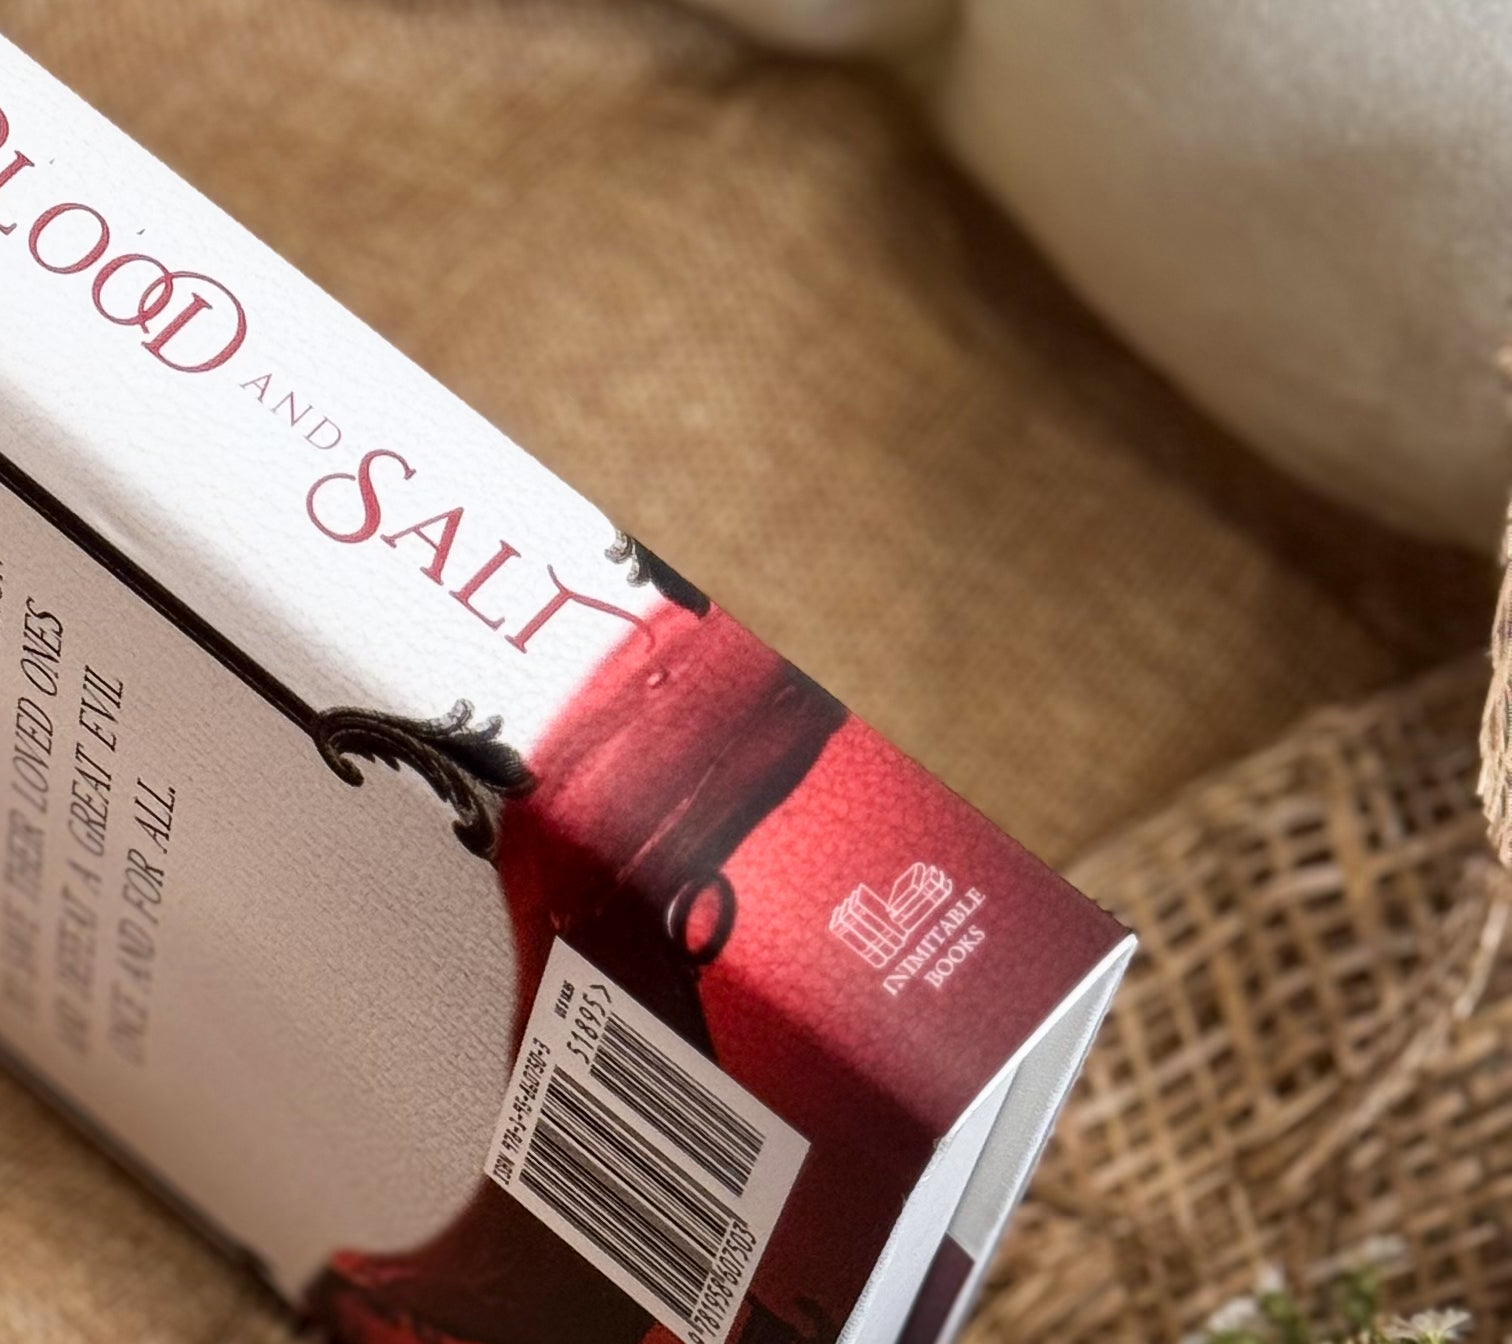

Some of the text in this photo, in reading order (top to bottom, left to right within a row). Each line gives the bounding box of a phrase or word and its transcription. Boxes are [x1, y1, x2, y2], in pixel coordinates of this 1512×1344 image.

[239, 372, 343, 451] AND
[306, 449, 656, 654] SALT
[19, 598, 64, 696] ONES
[79, 664, 124, 750] EVIL
[11, 696, 56, 813] LOVED
[67, 747, 113, 856] GREAT
[133, 775, 176, 854] ALL.
[123, 847, 164, 923] FOR
[883, 887, 986, 996] INIMITABLE
[924, 924, 986, 988] BOOKS
[492, 1154, 516, 1186] ISBN
